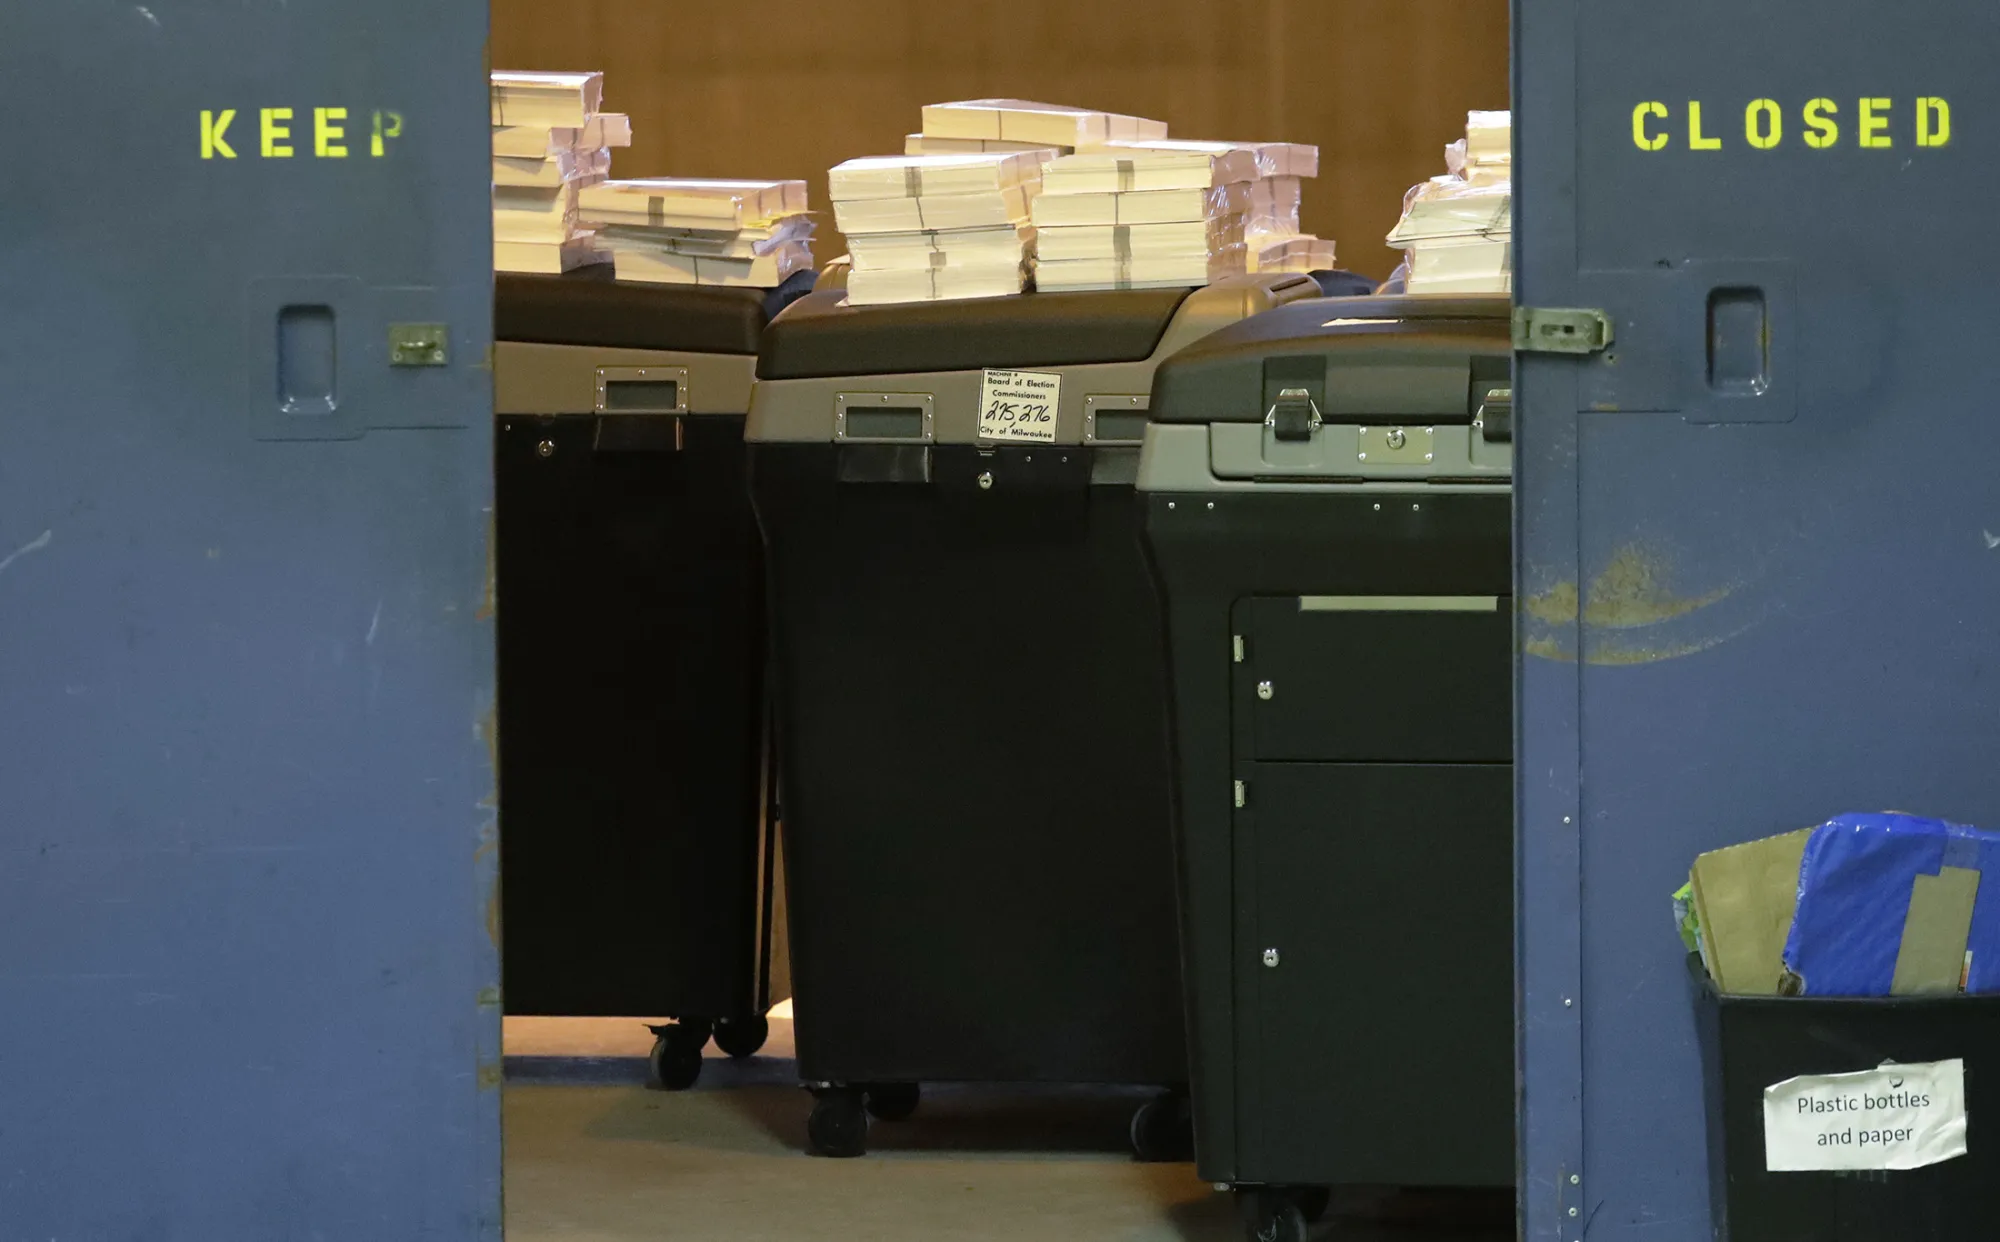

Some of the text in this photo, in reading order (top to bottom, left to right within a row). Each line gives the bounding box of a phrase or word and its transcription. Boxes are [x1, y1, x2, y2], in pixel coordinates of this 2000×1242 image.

[200, 107, 403, 159] KEEP
[1632, 97, 1950, 151] CLOSED
[1027, 380, 1055, 388] Election
[992, 389, 1046, 400] Commissioners
[980, 426, 994, 434] City
[1011, 429, 1052, 438] Milwaukee
[1798, 1091, 1930, 1114] Plastic bottles
[1817, 1127, 1913, 1147] and paper
